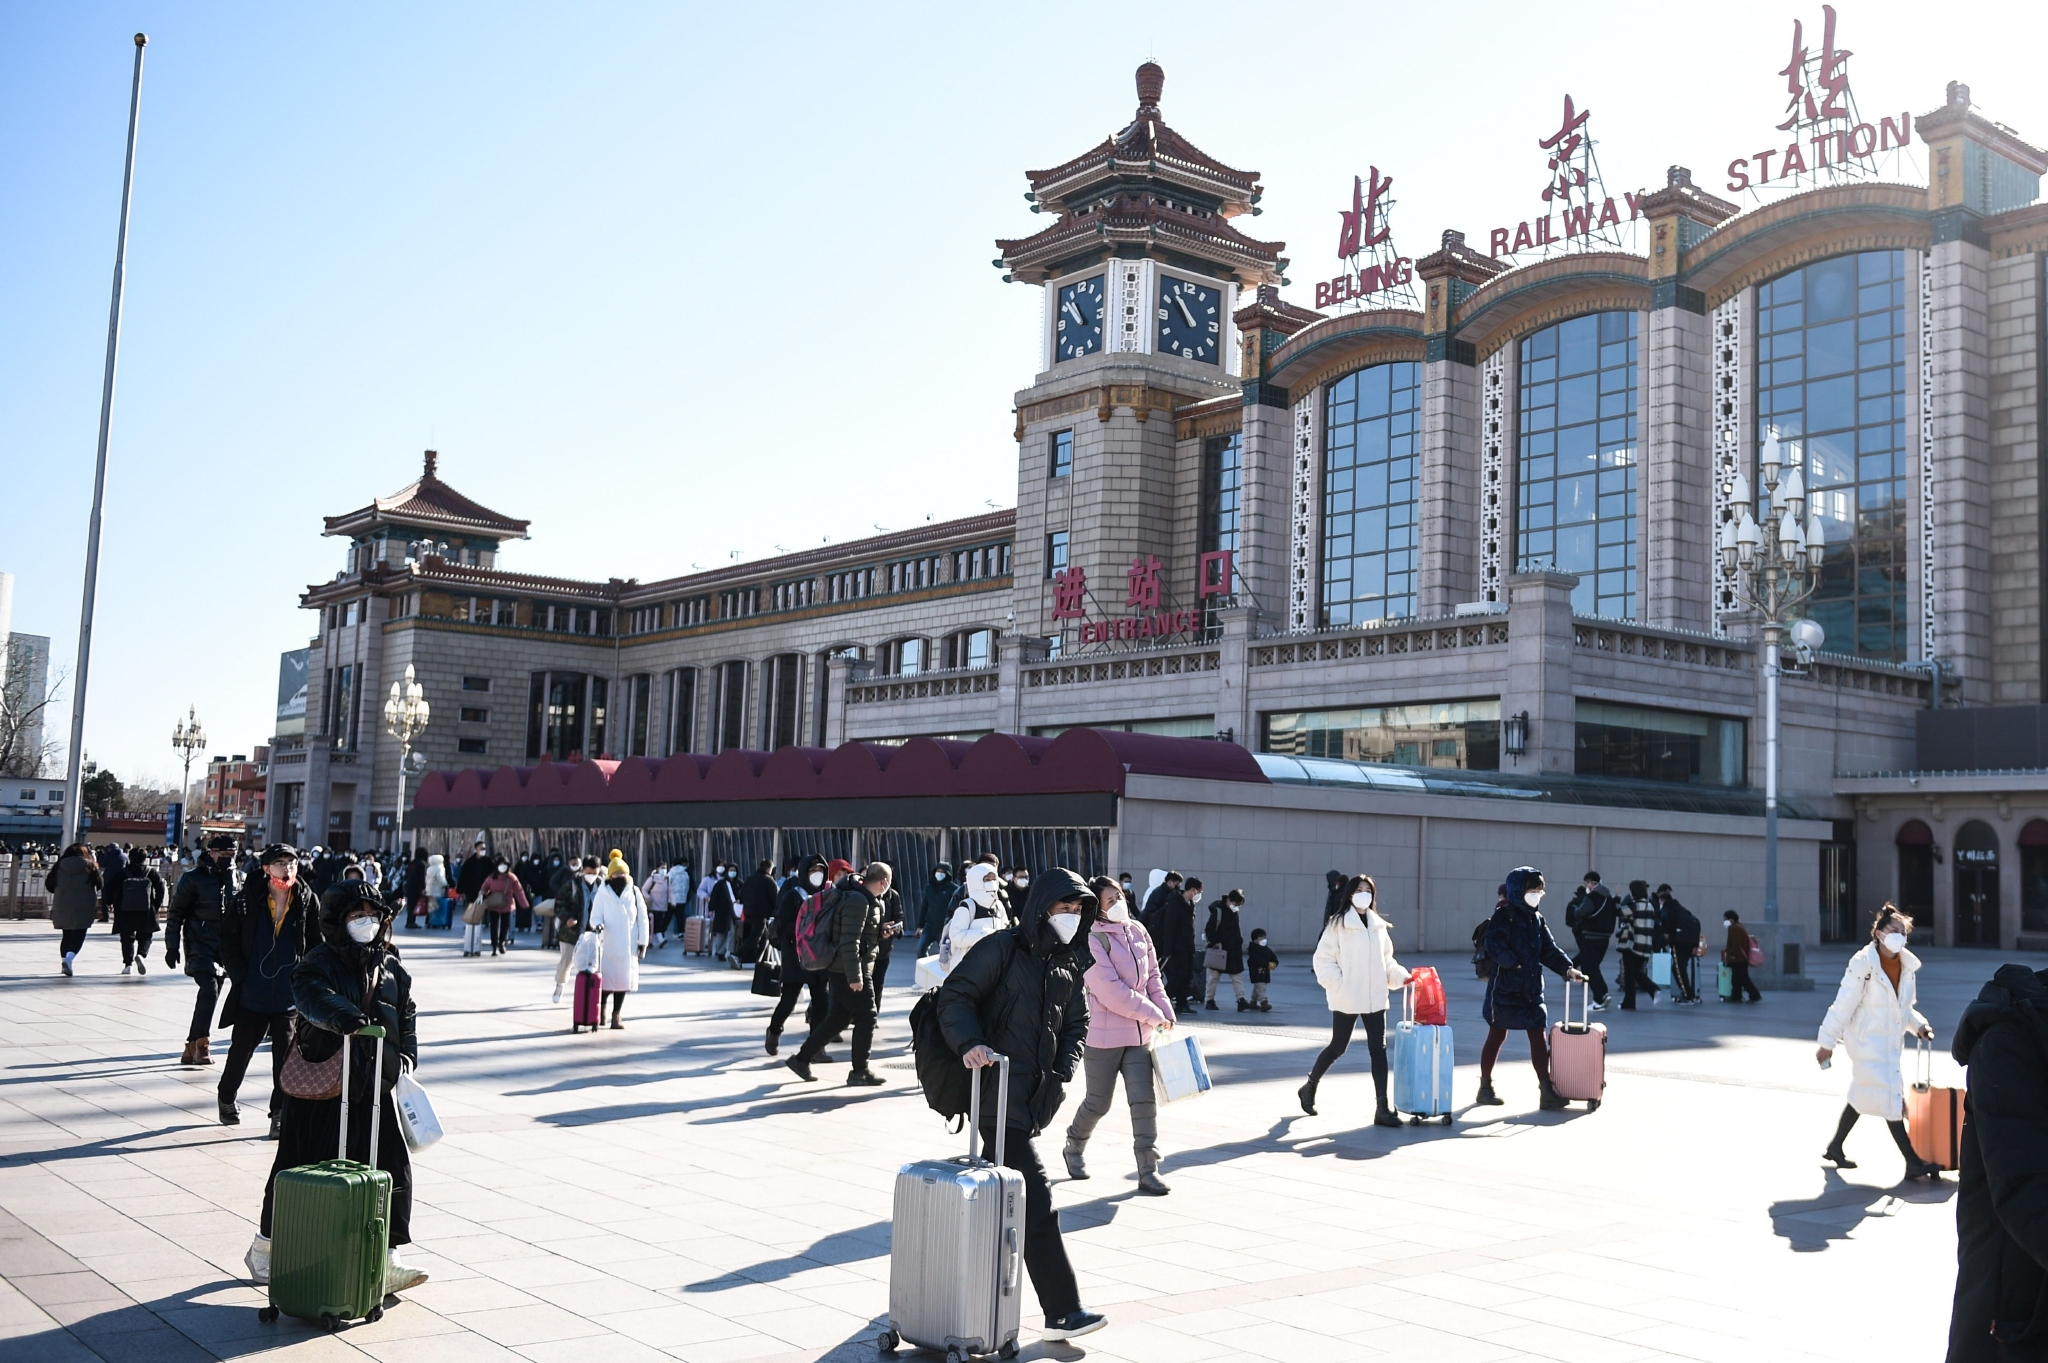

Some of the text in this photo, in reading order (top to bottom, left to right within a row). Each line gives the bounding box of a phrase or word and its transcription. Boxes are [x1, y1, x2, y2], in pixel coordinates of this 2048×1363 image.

[1338, 4, 1854, 260] 北 京 站
[1315, 111, 1911, 310] BEIJING RAILWAY STATION
[1077, 281, 1087, 293] 12
[1184, 282, 1196, 295] 12
[1096, 308, 1104, 319] 3
[1159, 308, 1169, 320] 9
[1058, 319, 1066, 331] 9
[1208, 321, 1219, 333] 3
[1075, 346, 1084, 358] 6
[1183, 347, 1193, 359] 6
[1052, 549, 1232, 621] 进站口
[1081, 608, 1202, 644] ENTRANCE
